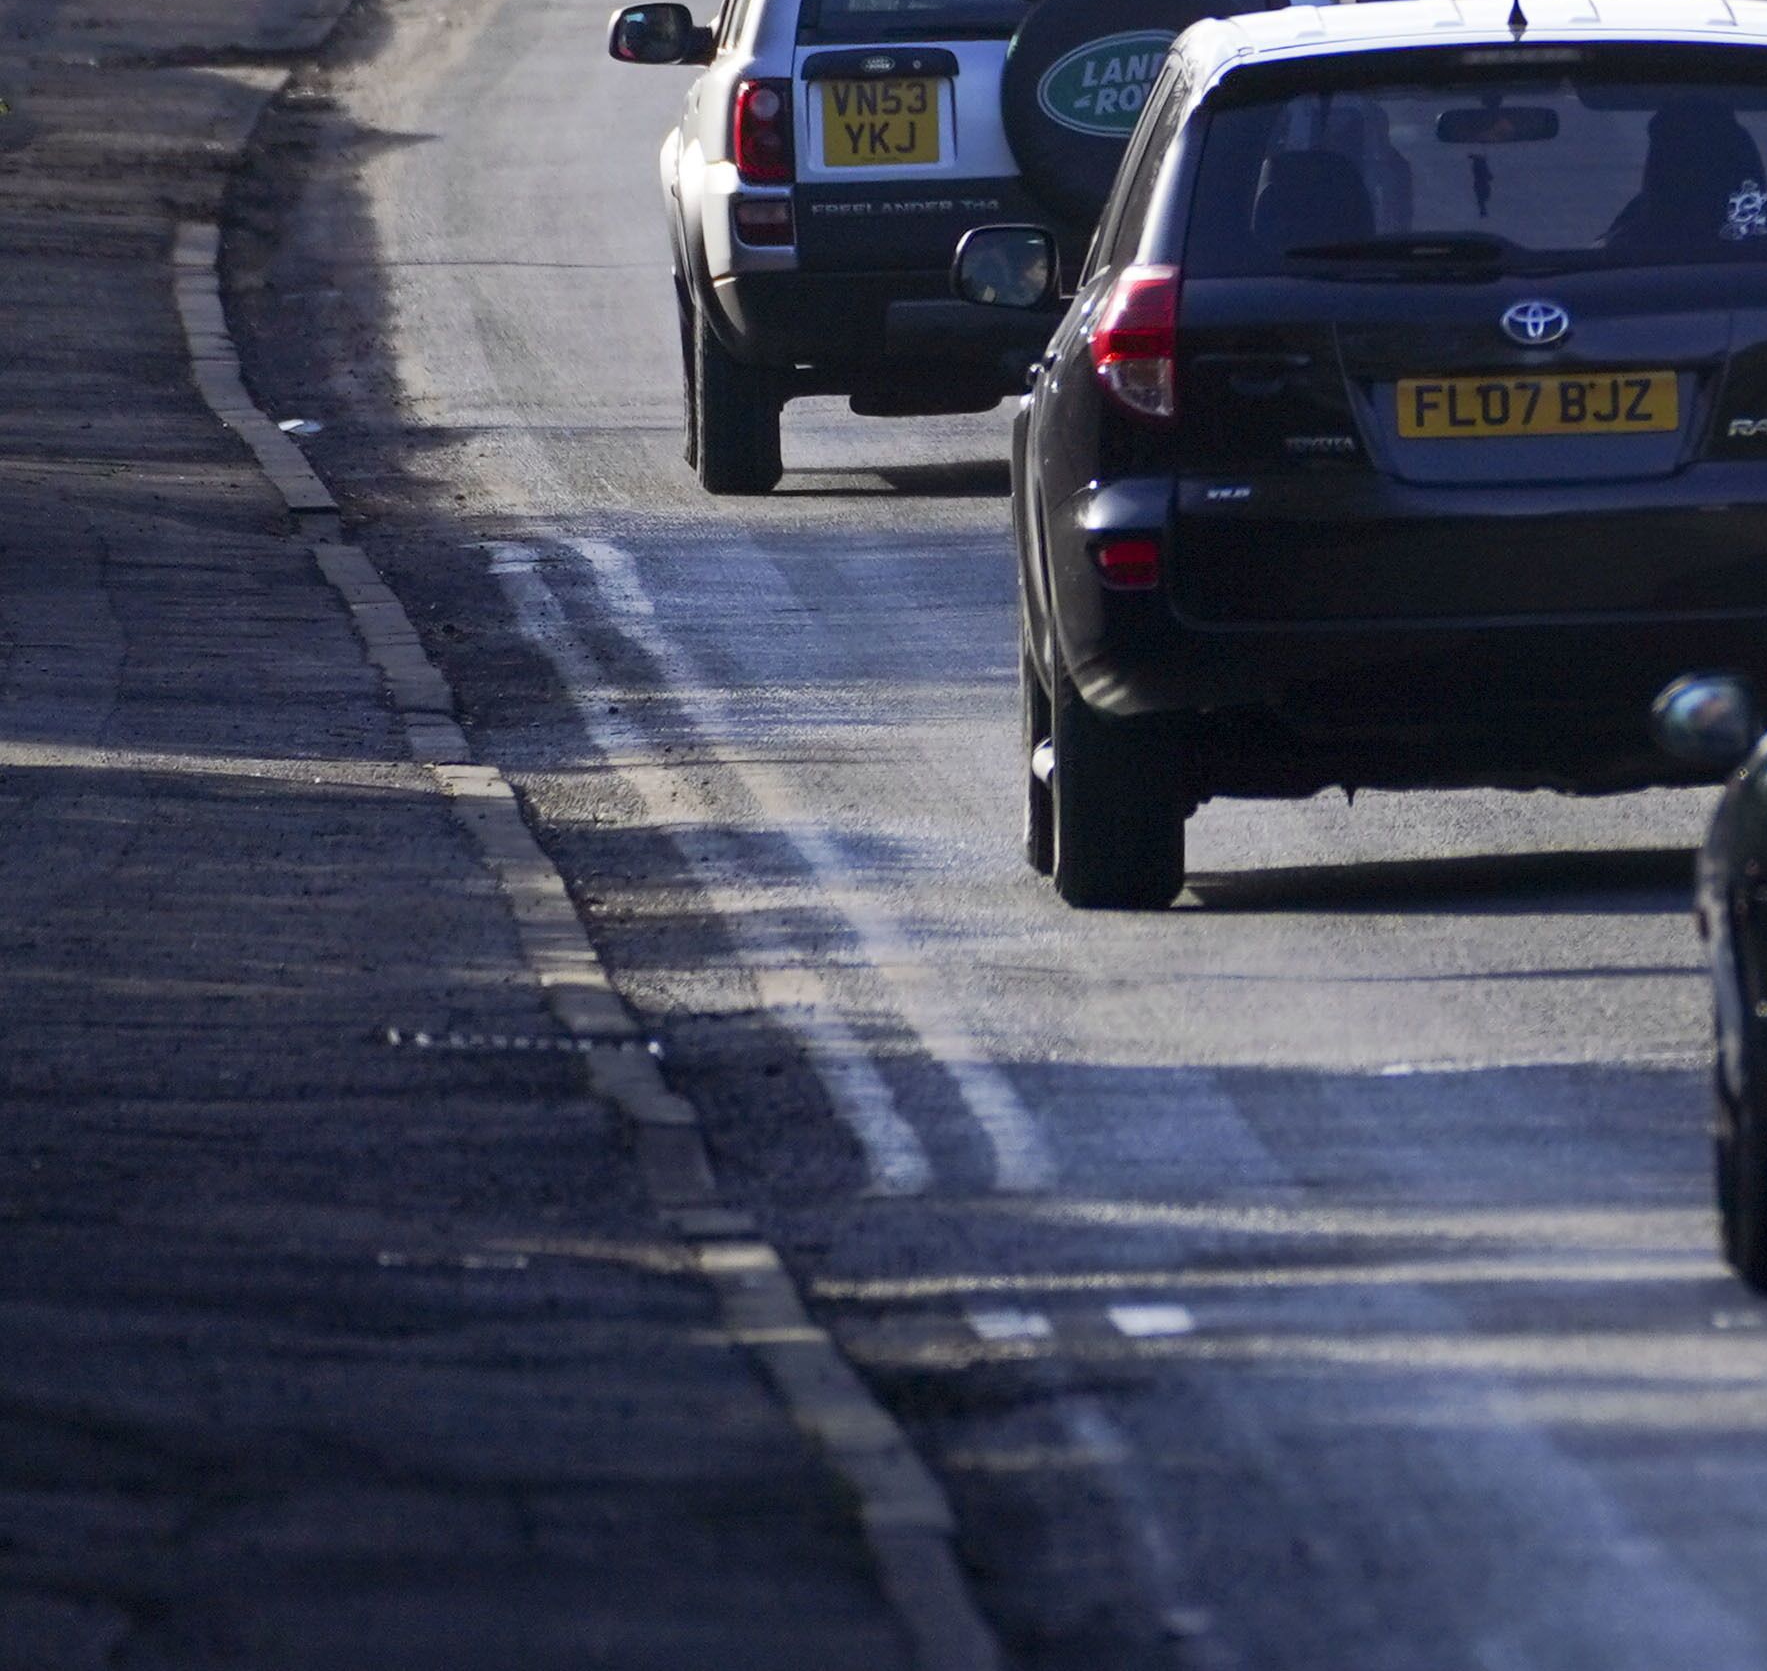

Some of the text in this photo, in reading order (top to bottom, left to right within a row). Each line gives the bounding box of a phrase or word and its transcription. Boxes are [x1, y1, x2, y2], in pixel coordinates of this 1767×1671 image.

[831, 81, 928, 116] VN53
[845, 121, 917, 155] YKJ
[1415, 379, 1653, 428] FL07 BJZ
